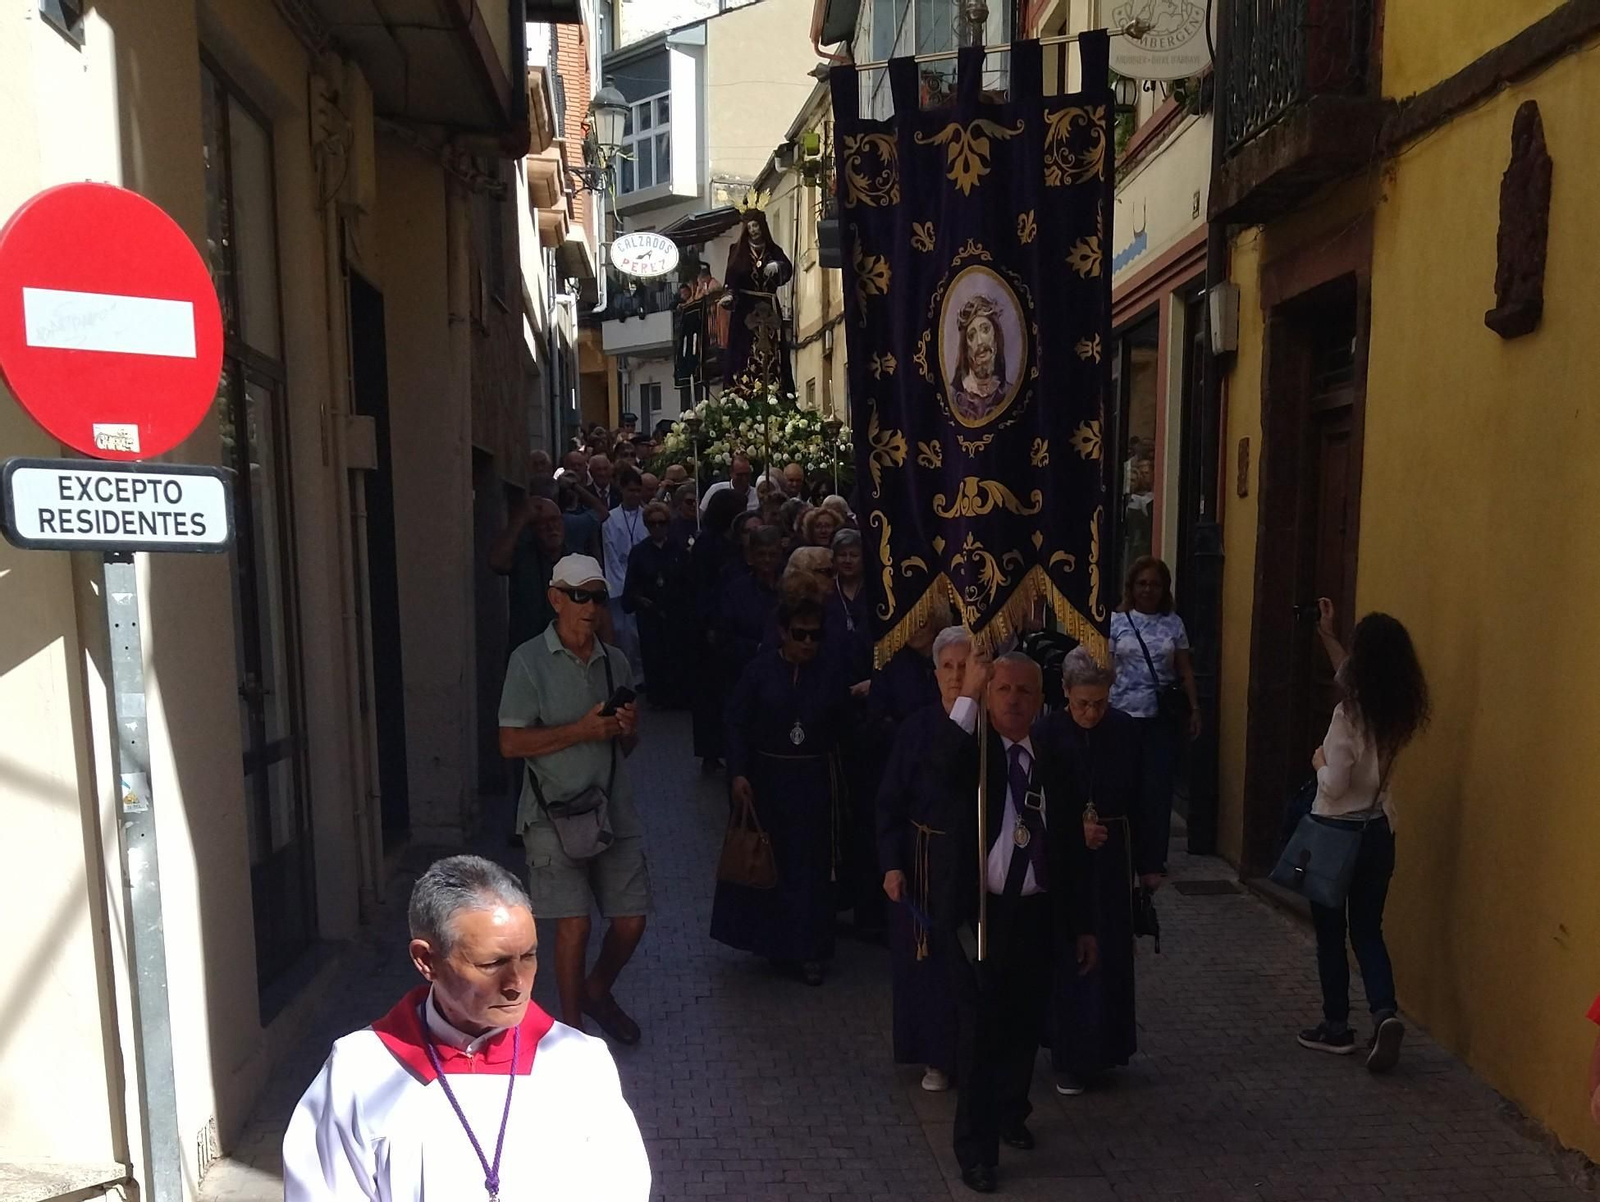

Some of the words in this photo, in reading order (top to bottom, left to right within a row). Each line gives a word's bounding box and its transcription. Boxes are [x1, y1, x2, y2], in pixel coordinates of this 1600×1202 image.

[1118, 17, 1199, 48] GMBERGEN
[617, 236, 673, 254] CALZADOS
[58, 475, 183, 504] EXCEPTO
[38, 508, 207, 536] RESIDENTES
